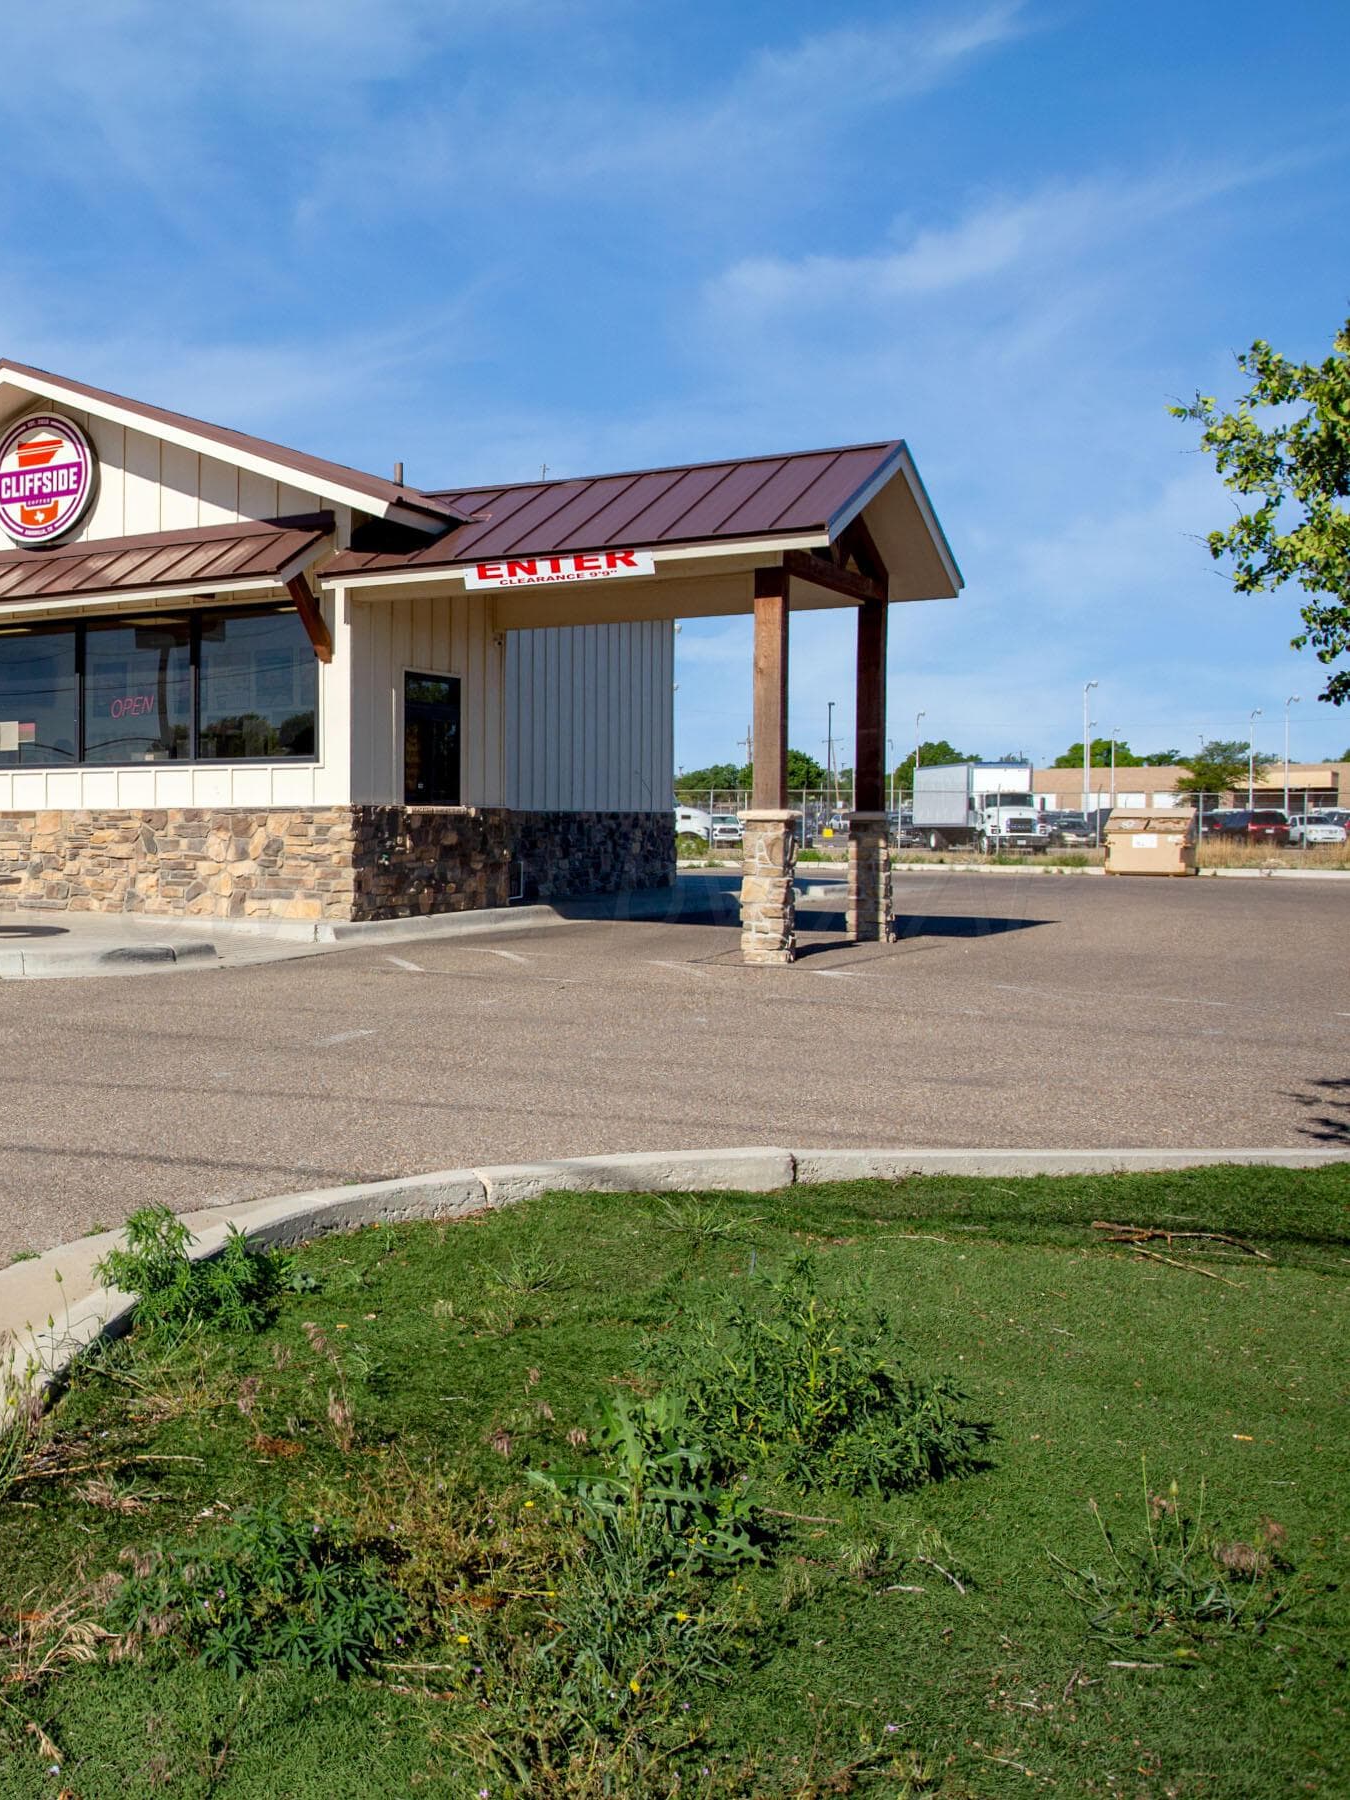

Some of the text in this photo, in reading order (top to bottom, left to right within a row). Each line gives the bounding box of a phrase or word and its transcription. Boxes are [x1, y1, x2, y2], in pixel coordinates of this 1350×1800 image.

[1, 467, 78, 499] CLIFFSIDE
[476, 549, 638, 580] ENTER
[500, 572, 585, 585] CLEARANCE
[111, 695, 154, 719] OPEN
